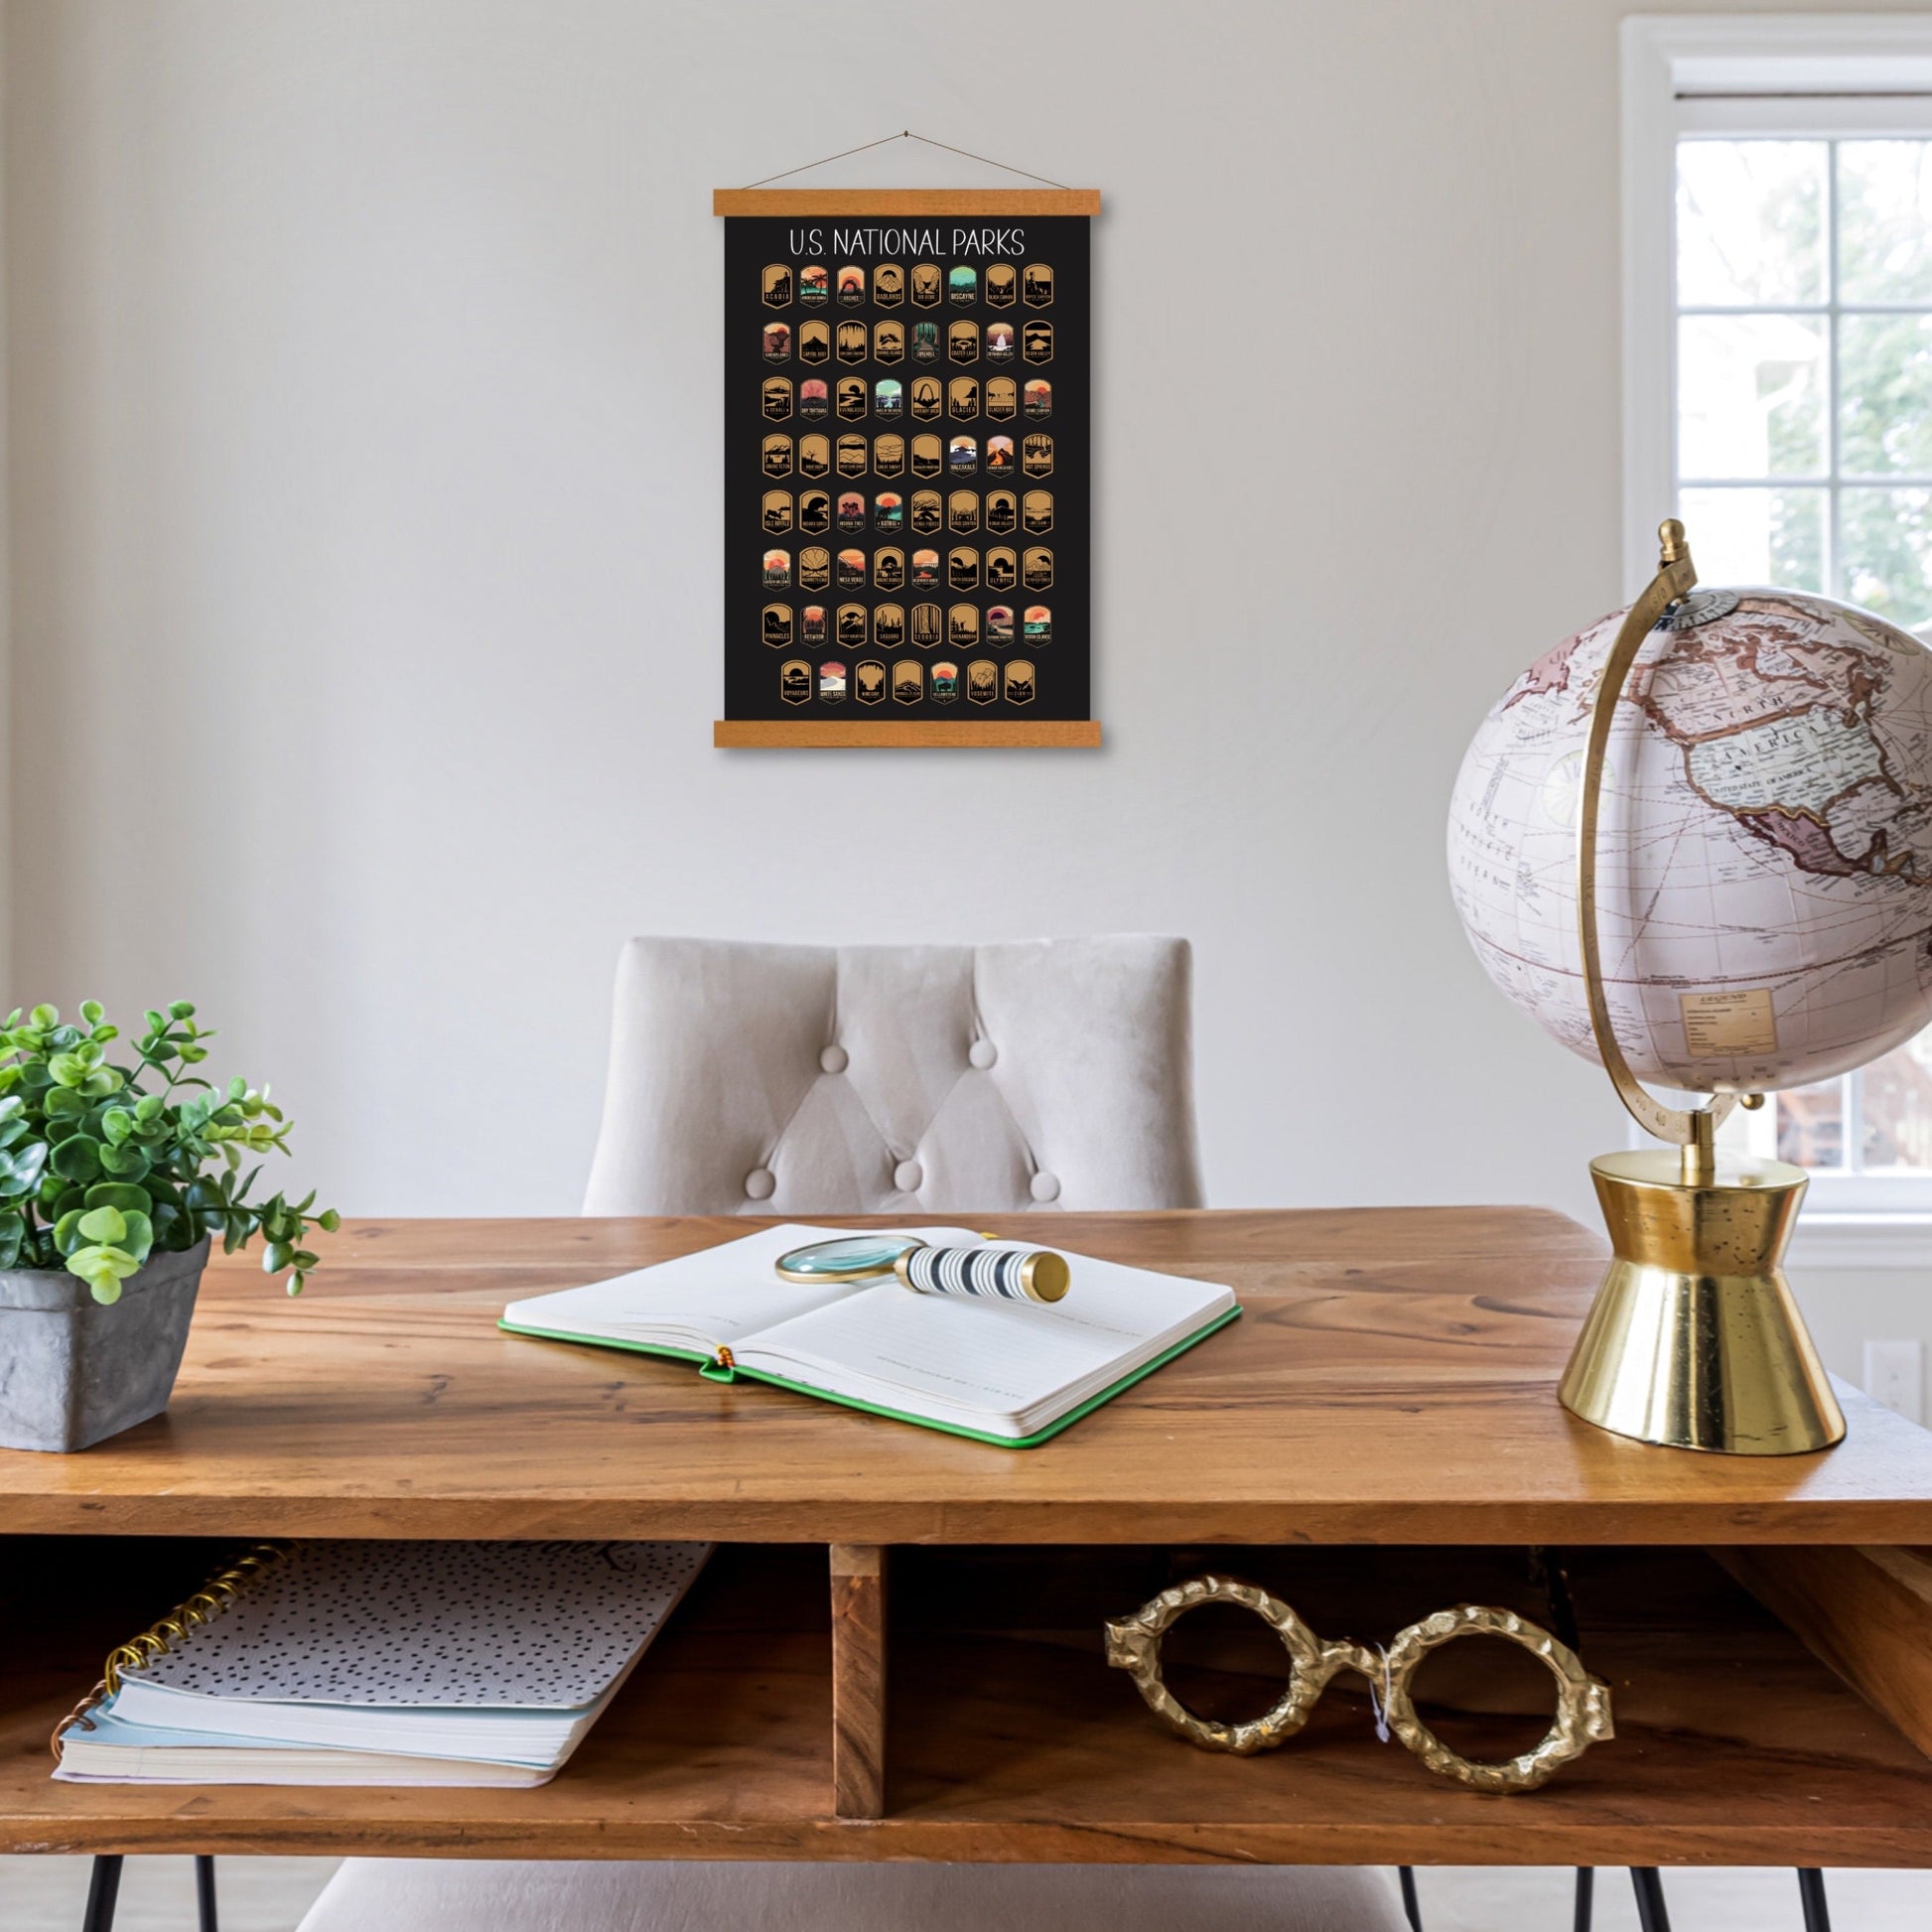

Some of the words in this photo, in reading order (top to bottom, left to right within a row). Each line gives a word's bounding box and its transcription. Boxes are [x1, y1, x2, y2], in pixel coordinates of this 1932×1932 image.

[790, 228, 827, 256] U.S.
[834, 228, 947, 256] NATIONAL
[953, 228, 1026, 256] PARKS
[1777, 818, 1805, 846] MEXICO
[1700, 994, 1747, 1003] LEGEND
